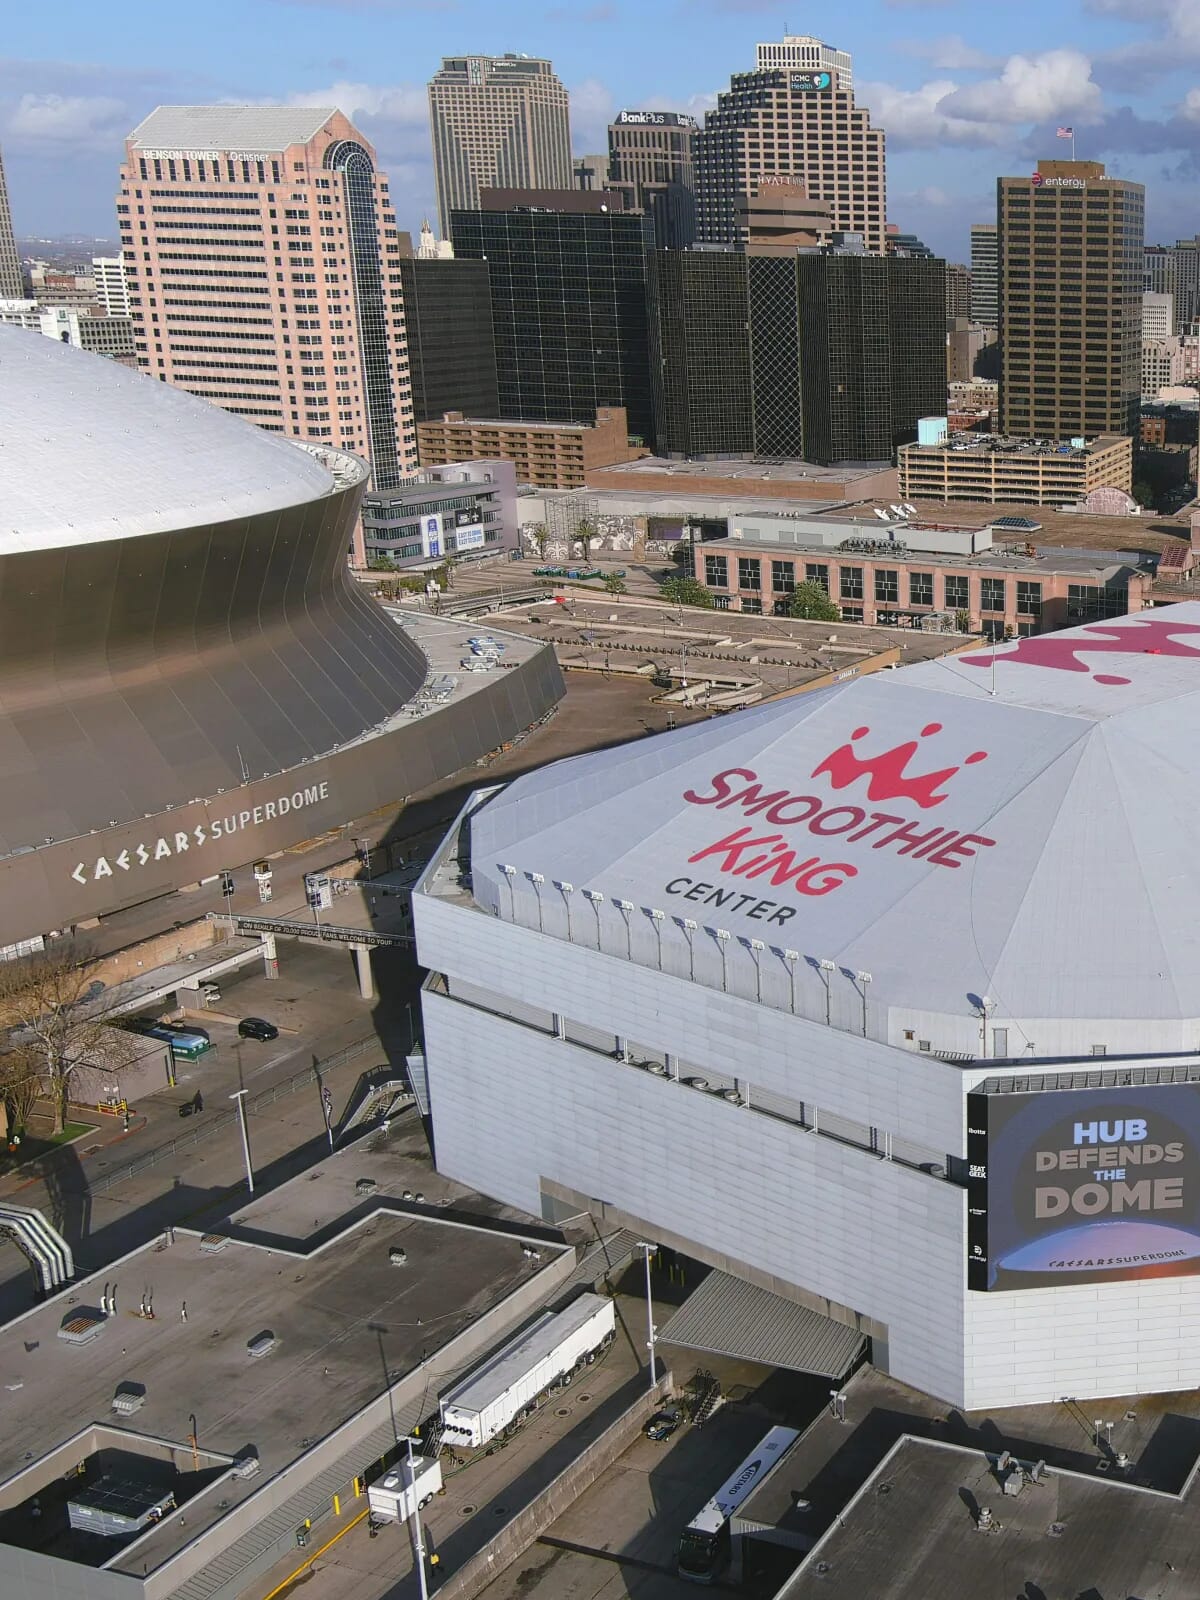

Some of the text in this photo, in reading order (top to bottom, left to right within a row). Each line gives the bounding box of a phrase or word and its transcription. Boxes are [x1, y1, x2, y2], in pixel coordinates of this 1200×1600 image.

[621, 112, 665, 124] BankPlus
[143, 150, 269, 162] BENSON TOWER Ochsner
[758, 176, 790, 186] HYATT
[1045, 177, 1086, 188] entergy
[683, 768, 996, 868] SMOOTHIE
[71, 782, 329, 885] CAESARS SUPERDOME
[665, 878, 797, 926] CENTER
[339, 933, 366, 943] WELCOME
[1073, 1118, 1148, 1145] HUB
[1036, 1142, 1185, 1172] DEFENDS
[1093, 1168, 1126, 1181] THE
[1035, 1177, 1184, 1218] DOME
[1048, 1249, 1188, 1268] CAESARS SUPERDOME
[729, 1469, 755, 1495] HOTARD
